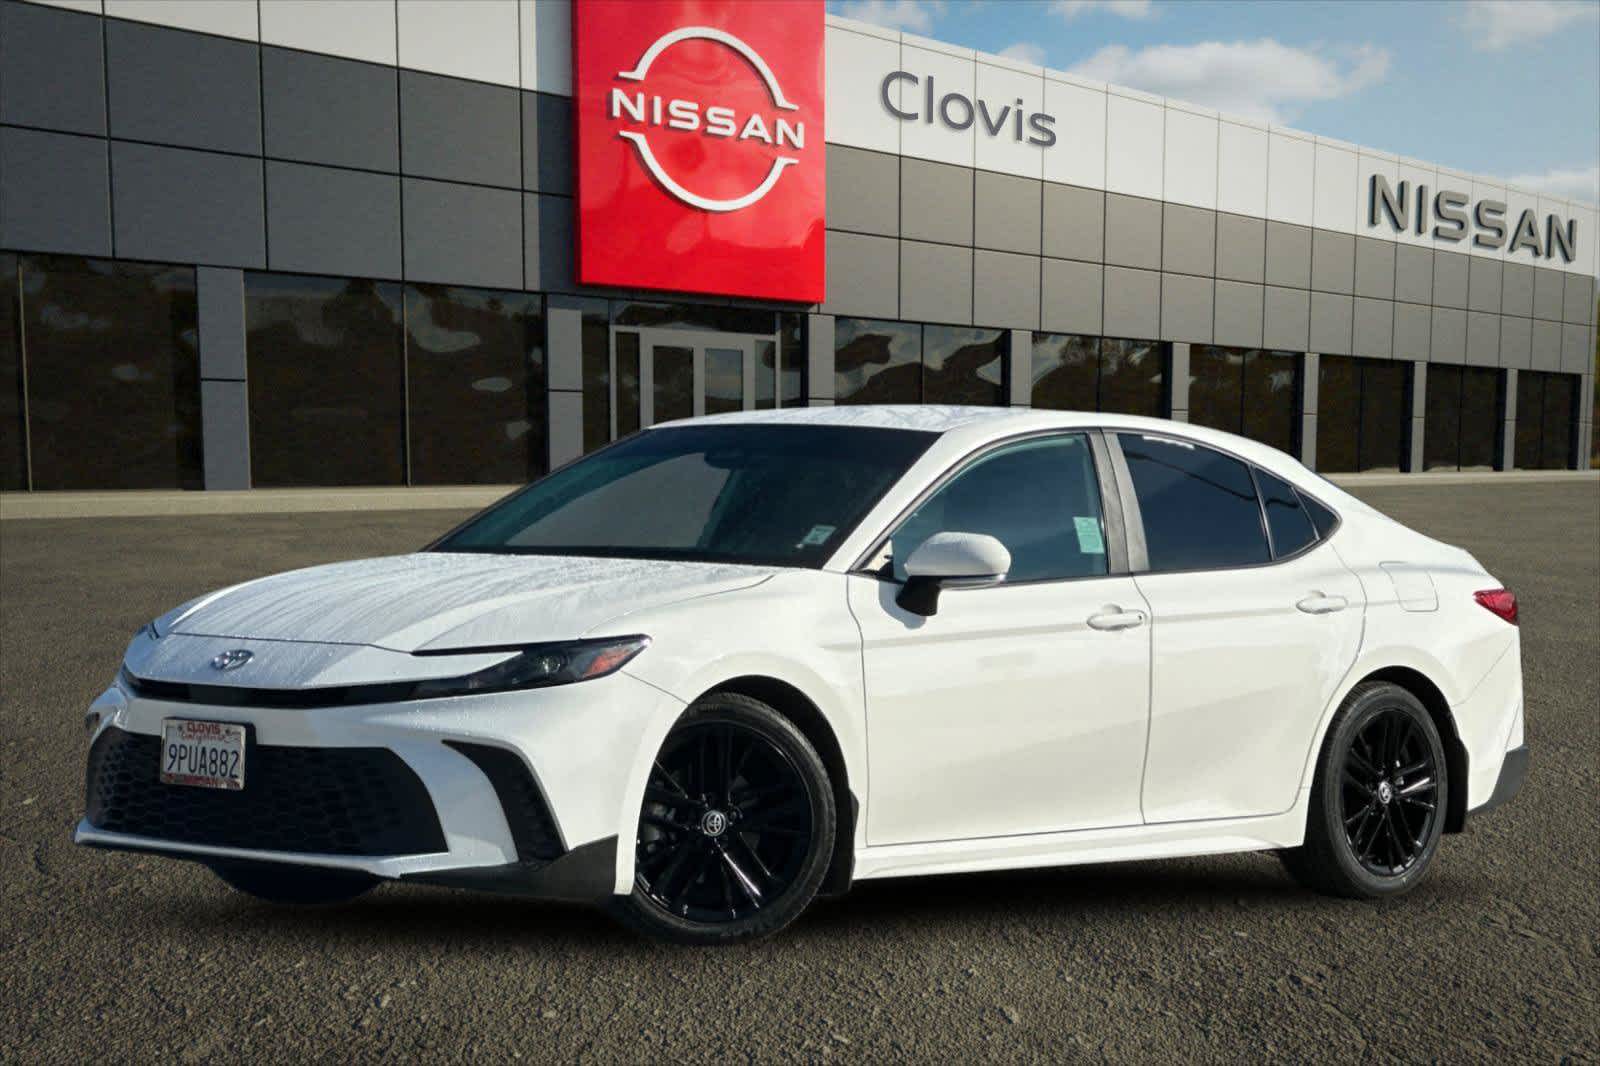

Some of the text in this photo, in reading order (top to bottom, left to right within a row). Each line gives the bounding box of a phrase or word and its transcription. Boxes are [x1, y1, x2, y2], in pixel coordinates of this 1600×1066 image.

[609, 87, 804, 149] NISSAN
[881, 71, 1057, 147] Clovis
[1368, 173, 1578, 263] NISSAN
[167, 743, 240, 779] 9PUA882
